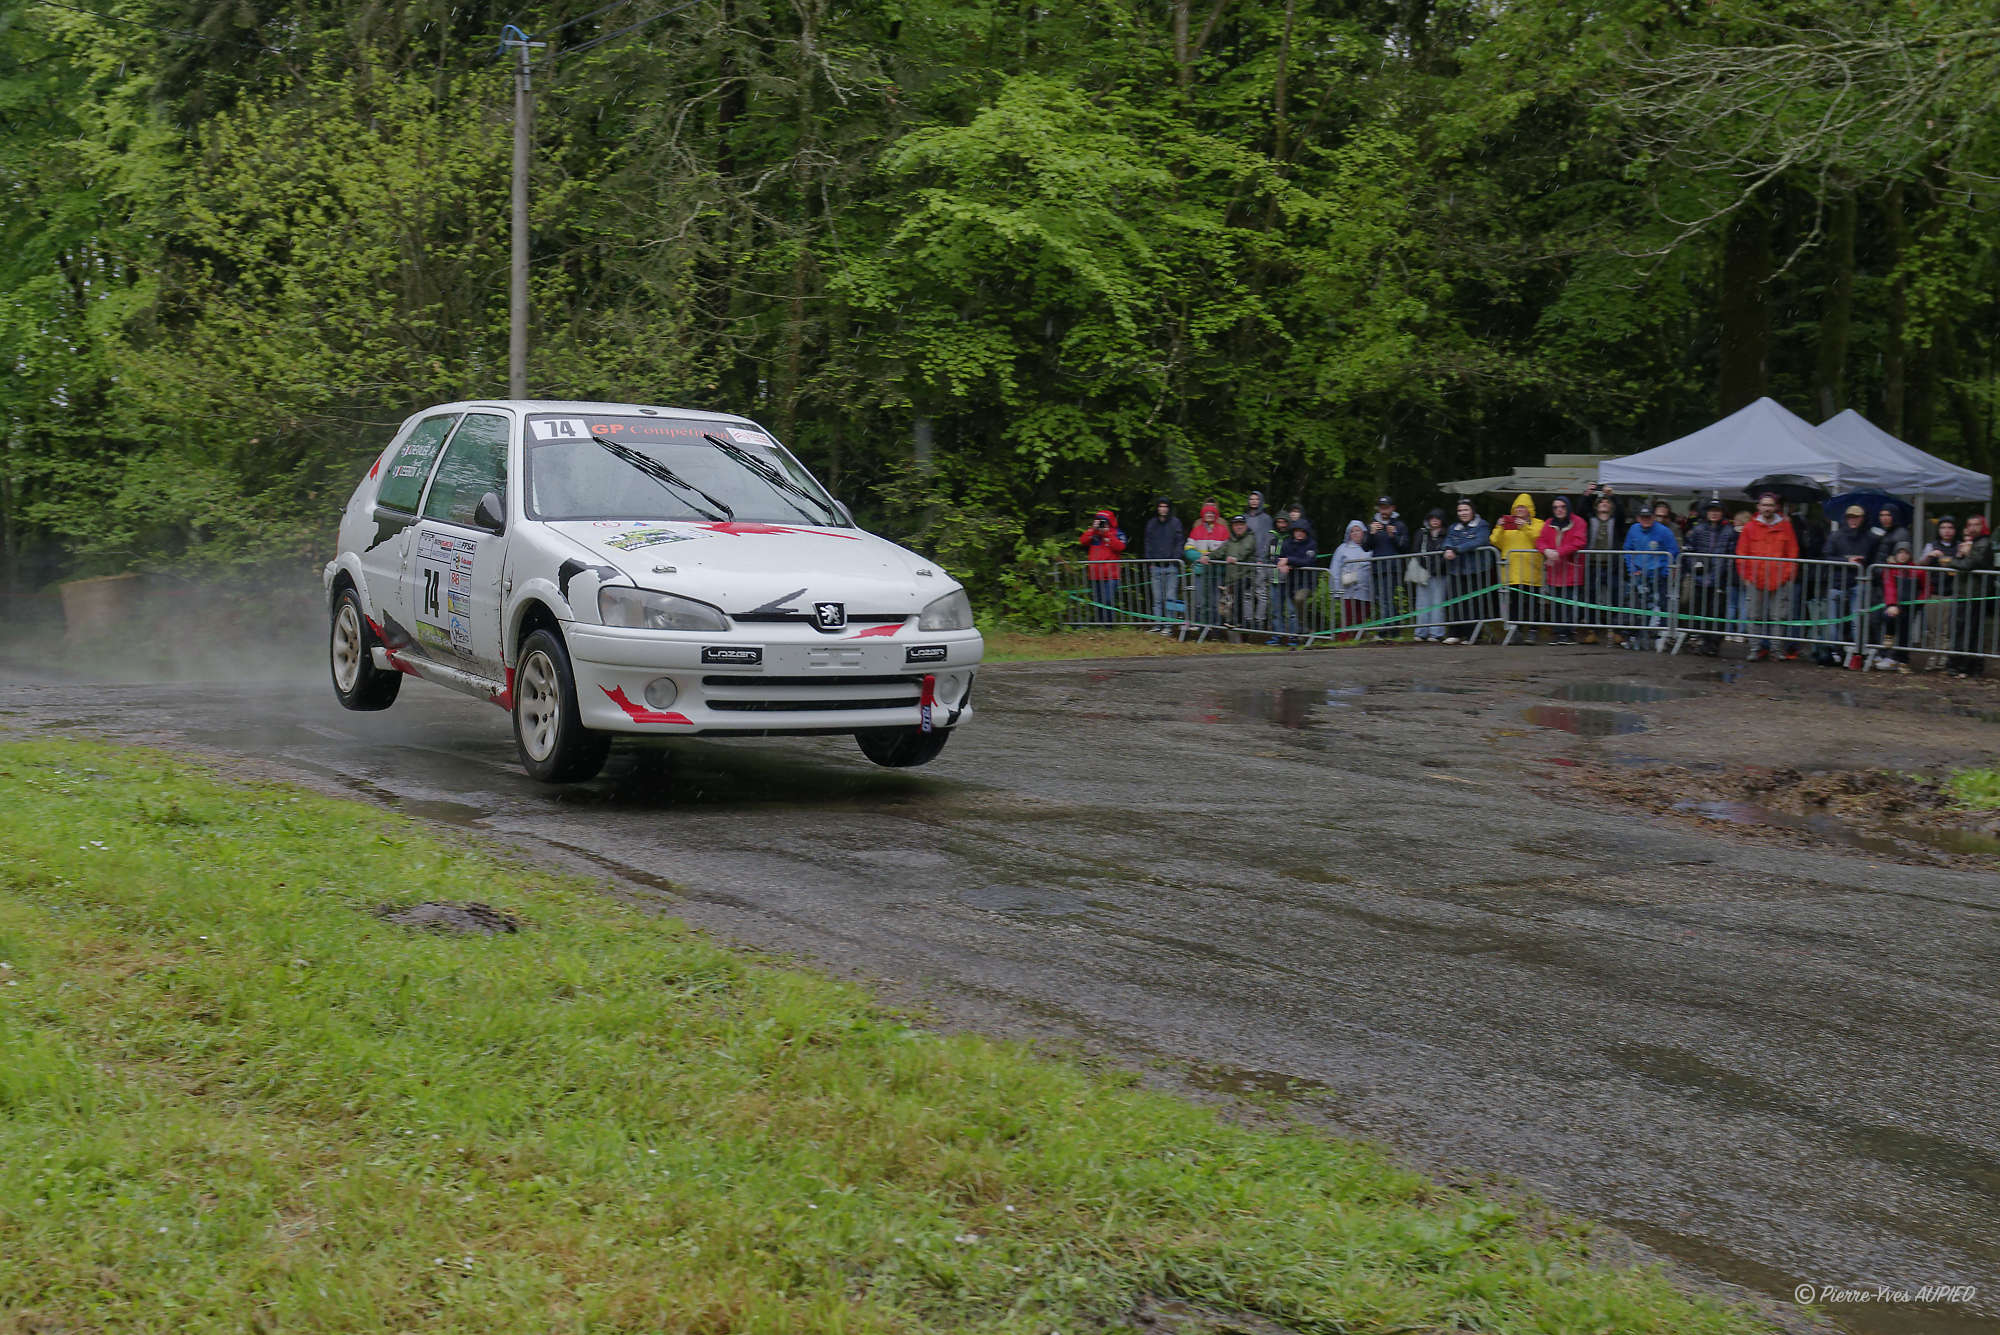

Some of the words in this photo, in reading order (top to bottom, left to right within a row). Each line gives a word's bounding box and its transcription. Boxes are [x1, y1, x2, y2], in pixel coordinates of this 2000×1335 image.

[544, 421, 576, 437] 74
[591, 424, 624, 435] GP
[424, 568, 440, 618] 74
